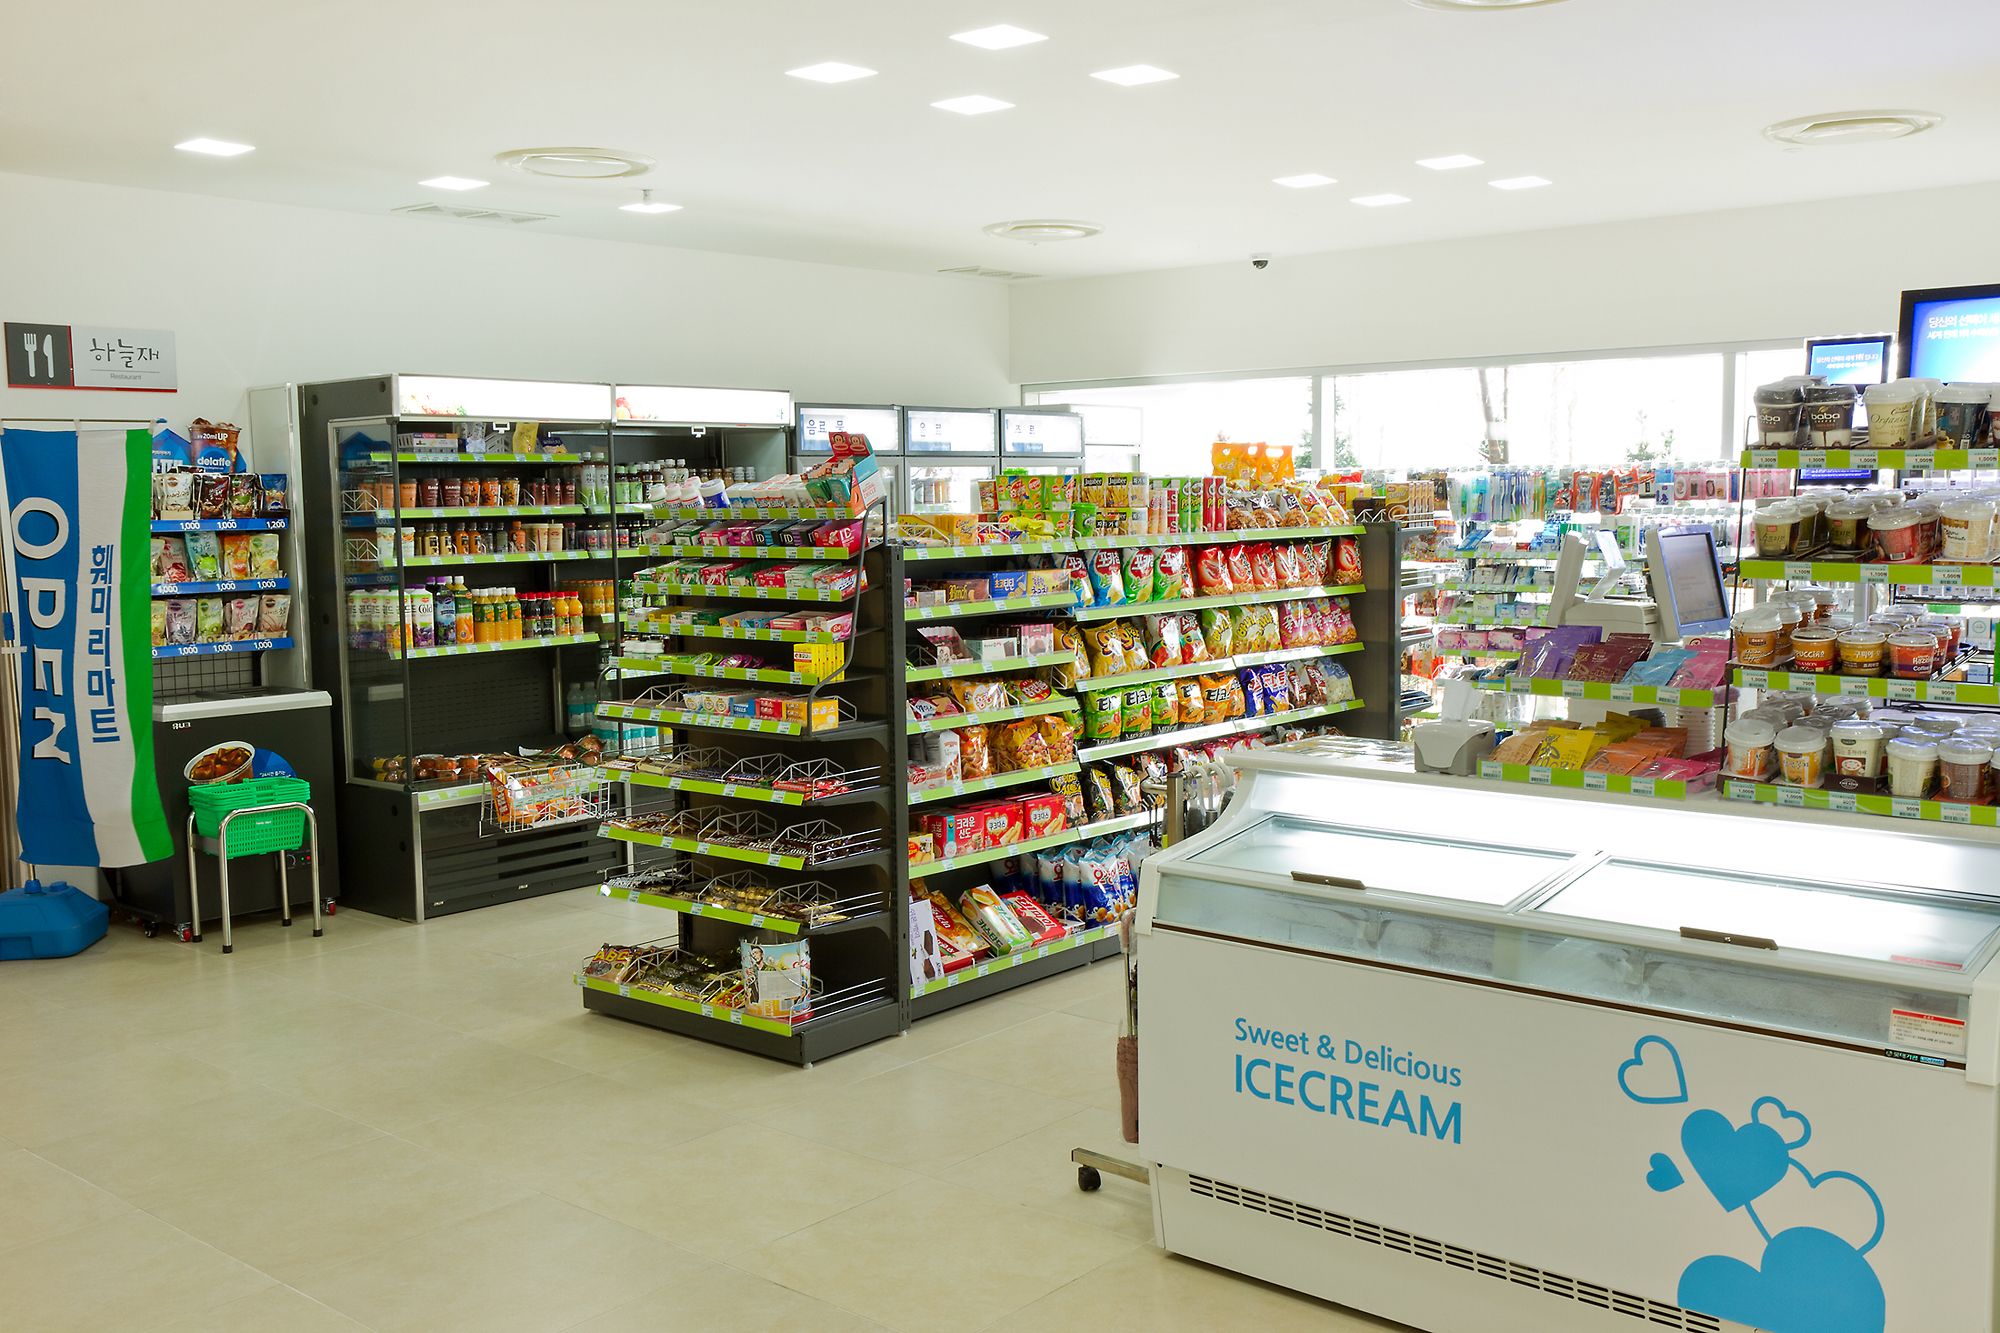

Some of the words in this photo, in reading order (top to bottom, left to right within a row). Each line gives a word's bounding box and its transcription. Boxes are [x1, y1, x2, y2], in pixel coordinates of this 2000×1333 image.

[89, 338, 159, 368] 하늘재
[197, 457, 231, 467] delaffe
[180, 522, 200, 530] 1,000
[216, 521, 237, 530] 1,000
[216, 582, 236, 592] 1,000
[257, 580, 276, 588] 1,000
[418, 604, 432, 614] Cold
[11, 497, 71, 764] OPEN
[178, 646, 198, 655] 1,000
[214, 644, 233, 652] 1,000
[254, 641, 273, 650] 1,000
[956, 816, 976, 830] 크라운
[1235, 1017, 1309, 1056] Sweet
[1316, 1034, 1336, 1061] &
[1344, 1039, 1462, 1088] Delicious
[1235, 1054, 1462, 1145] ICECREAM
